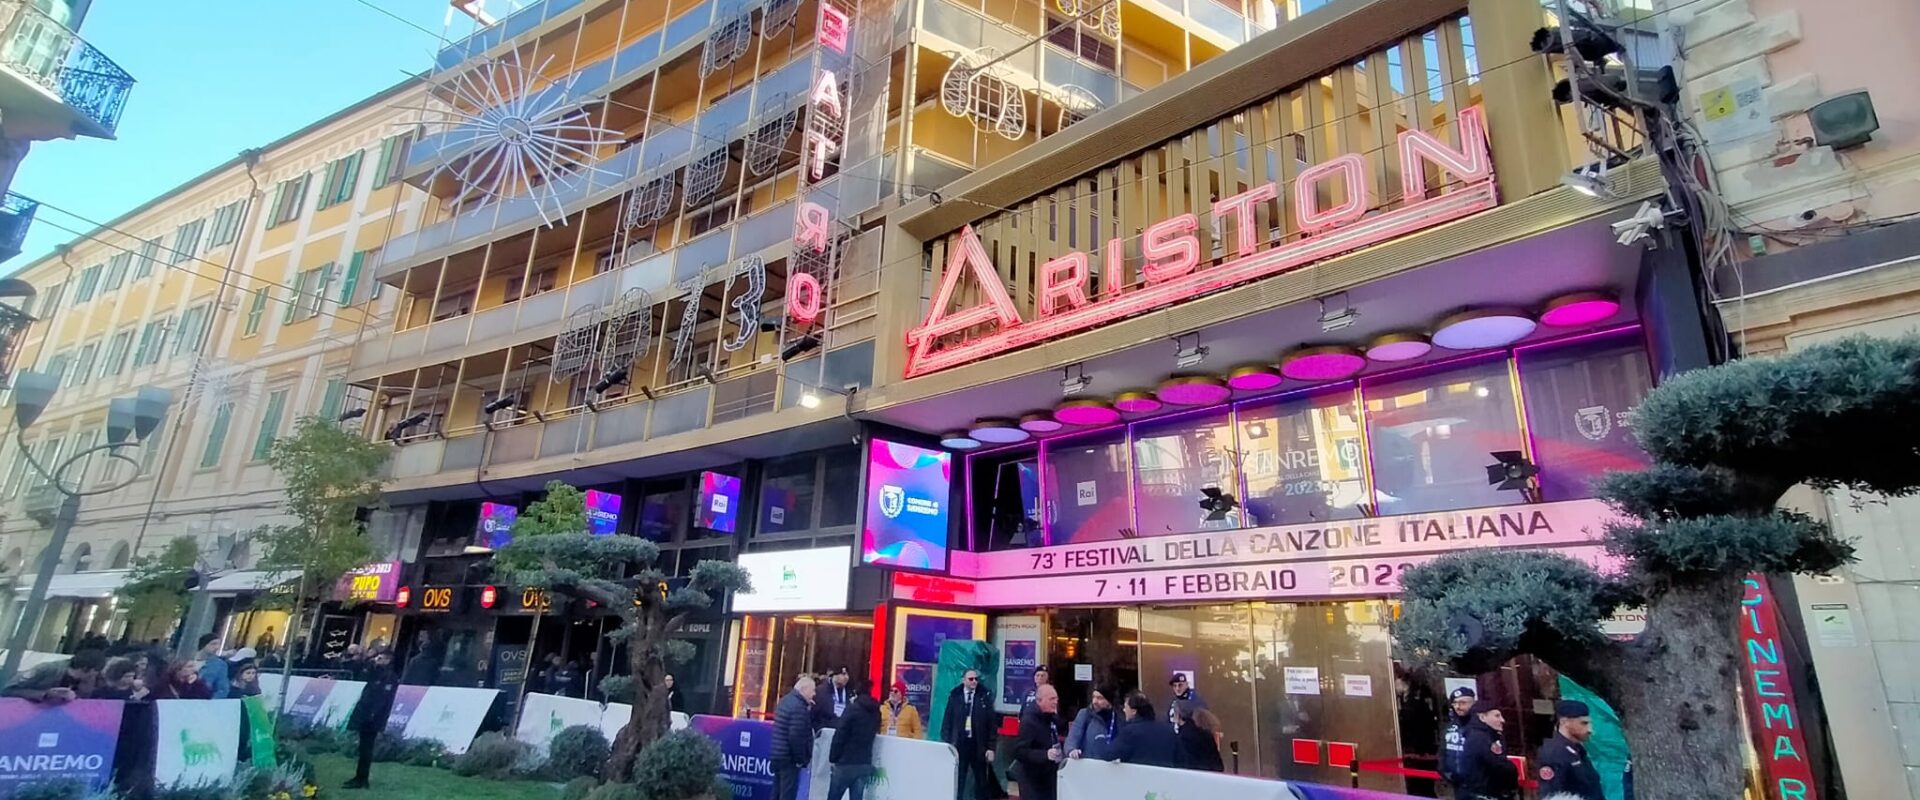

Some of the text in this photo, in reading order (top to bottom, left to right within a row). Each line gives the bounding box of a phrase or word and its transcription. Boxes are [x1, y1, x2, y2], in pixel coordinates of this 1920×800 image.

[1079, 487, 1095, 499] Rai
[1065, 542, 1154, 569] FESTIVAL
[1165, 537, 1237, 561] DELLA
[1250, 523, 1382, 555] CANZONE
[1399, 509, 1554, 544] ITALIANA
[352, 575, 381, 591] PUPO
[1095, 579, 1107, 597] 7
[1128, 577, 1147, 596] 11
[1165, 568, 1297, 595] FEBBRAIO
[424, 588, 452, 608] OVS
[0, 754, 103, 771] ANREMO
